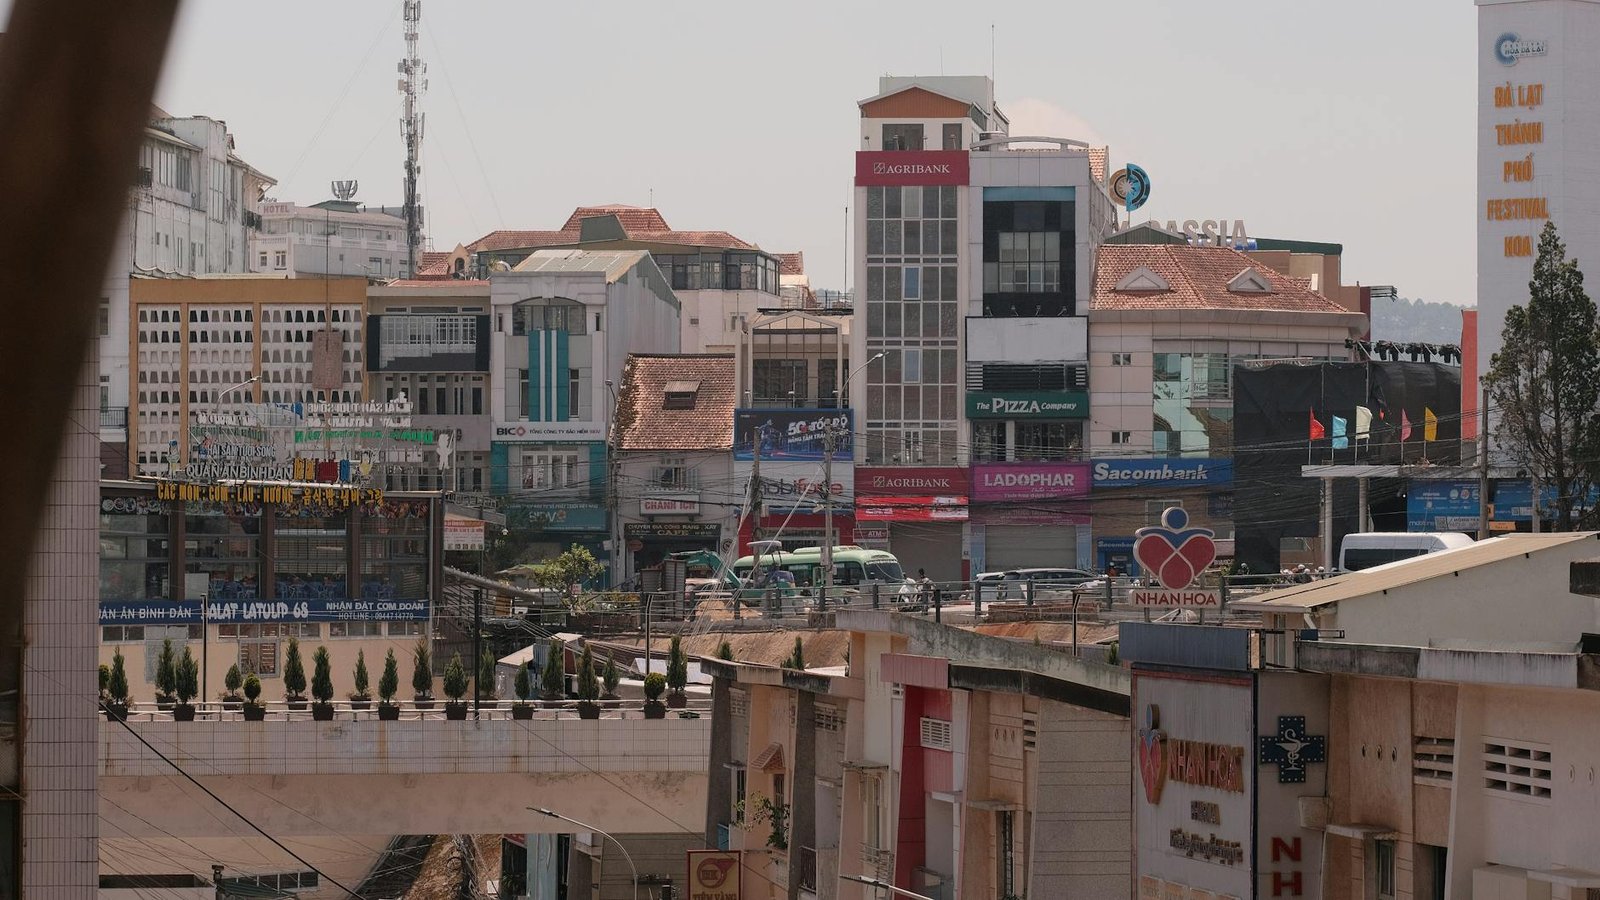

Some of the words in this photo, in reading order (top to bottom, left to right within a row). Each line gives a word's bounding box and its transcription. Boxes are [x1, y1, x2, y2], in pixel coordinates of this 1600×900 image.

[1494, 81, 1514, 108] ĐÀ
[1518, 84, 1543, 110] LẠT
[1495, 118, 1543, 145] THÀNH
[886, 164, 950, 174] AGRIBANK
[1504, 152, 1534, 182] PHỐ
[263, 204, 289, 214] HOTEL
[1487, 198, 1549, 221] FESTIVAL
[1504, 236, 1533, 257] HOA
[976, 402, 990, 410] The
[991, 397, 1041, 413] PIZZA
[1041, 402, 1077, 411] Company
[496, 427, 516, 436] BIC
[1094, 463, 1208, 480] Sacombank
[886, 478, 950, 488] AGRIBANK
[984, 474, 1075, 487] LADOPHAR
[1135, 593, 1180, 606] NHAN
[1183, 593, 1217, 606] HOA
[120, 605, 135, 620] ĂN
[139, 604, 165, 620] BÌNH
[169, 605, 192, 619] DÂN
[243, 601, 289, 620] LATULIP
[293, 601, 309, 620] 68
